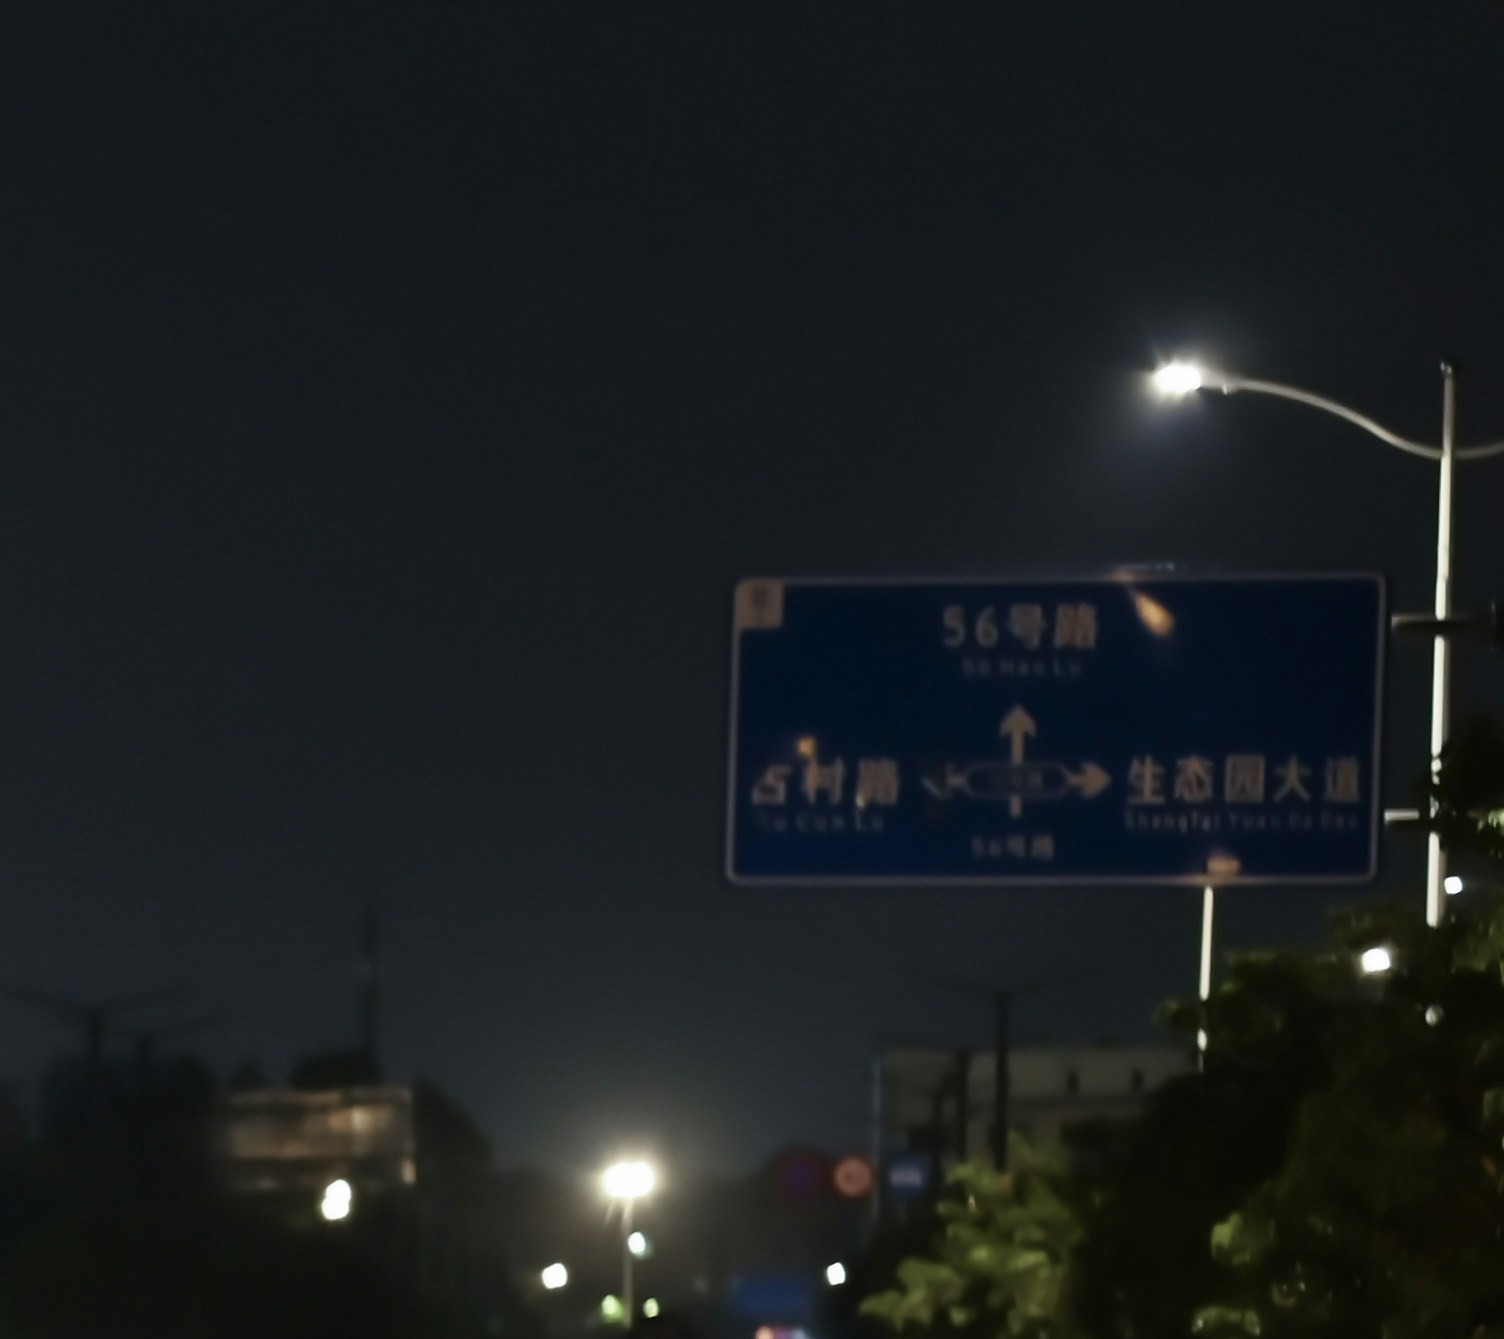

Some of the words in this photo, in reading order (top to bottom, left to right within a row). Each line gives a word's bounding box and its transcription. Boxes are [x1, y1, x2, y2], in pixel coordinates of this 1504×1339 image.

[942, 602, 1097, 650] 56号路
[1126, 754, 1361, 804] 生态园大道
